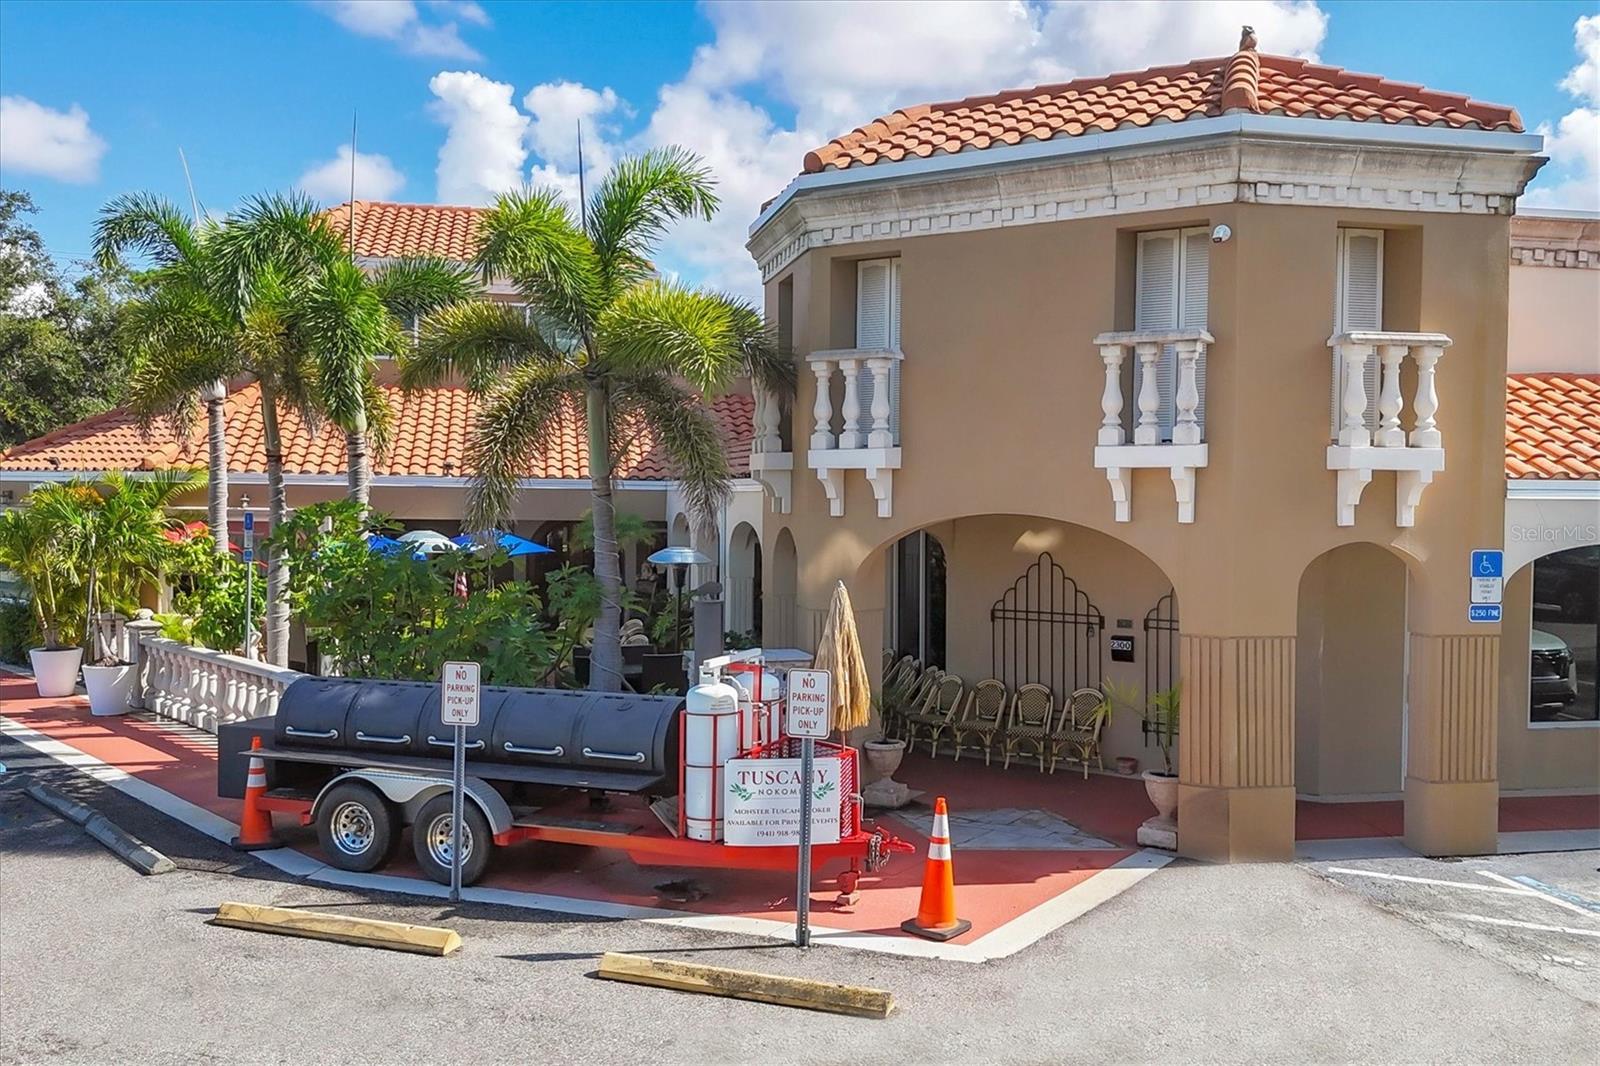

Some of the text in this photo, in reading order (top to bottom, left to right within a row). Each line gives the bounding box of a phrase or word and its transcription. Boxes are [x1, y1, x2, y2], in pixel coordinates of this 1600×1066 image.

[455, 670, 467, 680] NO
[802, 678, 815, 688] NO
[447, 684, 475, 693] PARKING
[447, 696, 474, 705] PICK-UP
[792, 692, 825, 702] PARKING
[451, 708, 469, 717] ONLY
[793, 706, 824, 716] PICK-UP
[798, 720, 818, 729] ONLY
[737, 769, 828, 785] TUSCAY
